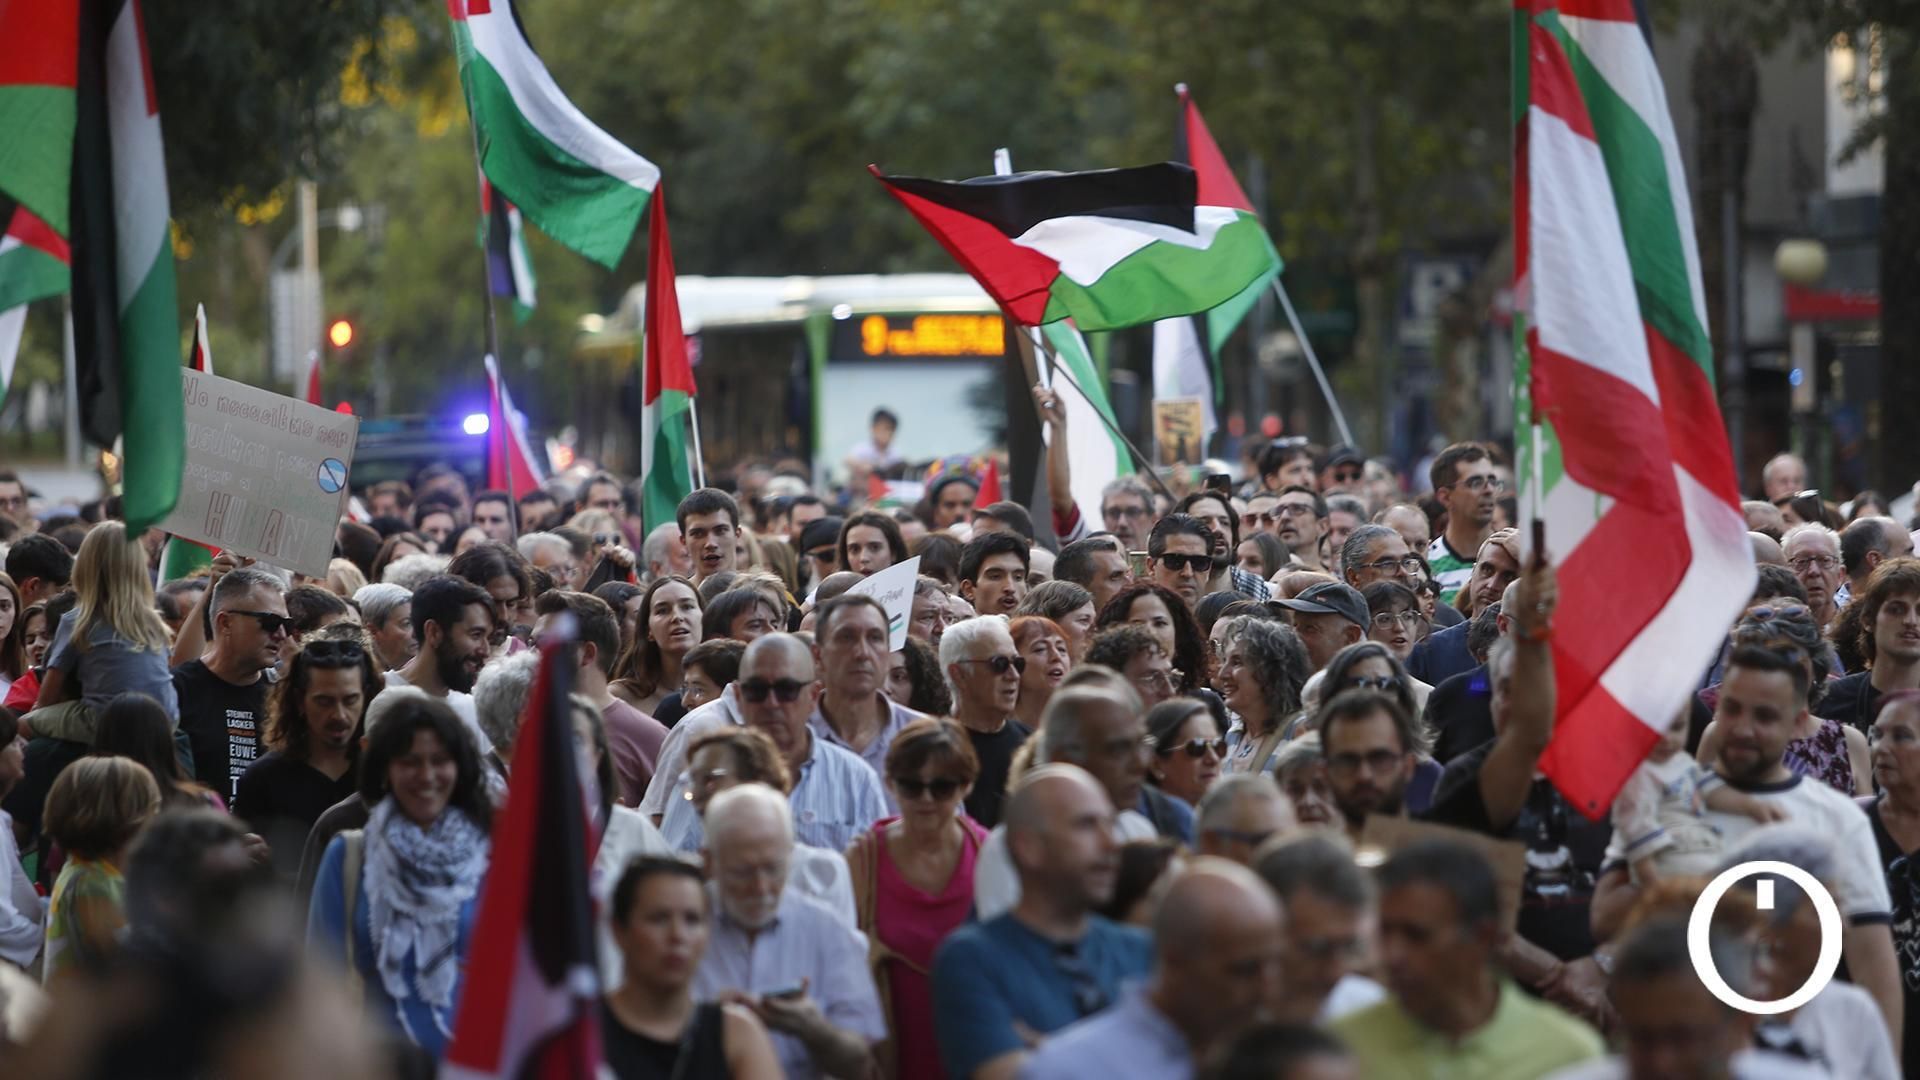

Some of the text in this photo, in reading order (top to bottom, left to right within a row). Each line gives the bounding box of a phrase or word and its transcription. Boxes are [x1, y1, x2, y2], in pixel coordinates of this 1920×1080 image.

[182, 375, 209, 407] No
[227, 719, 255, 730] LASKER
[230, 744, 256, 759] EUWE
